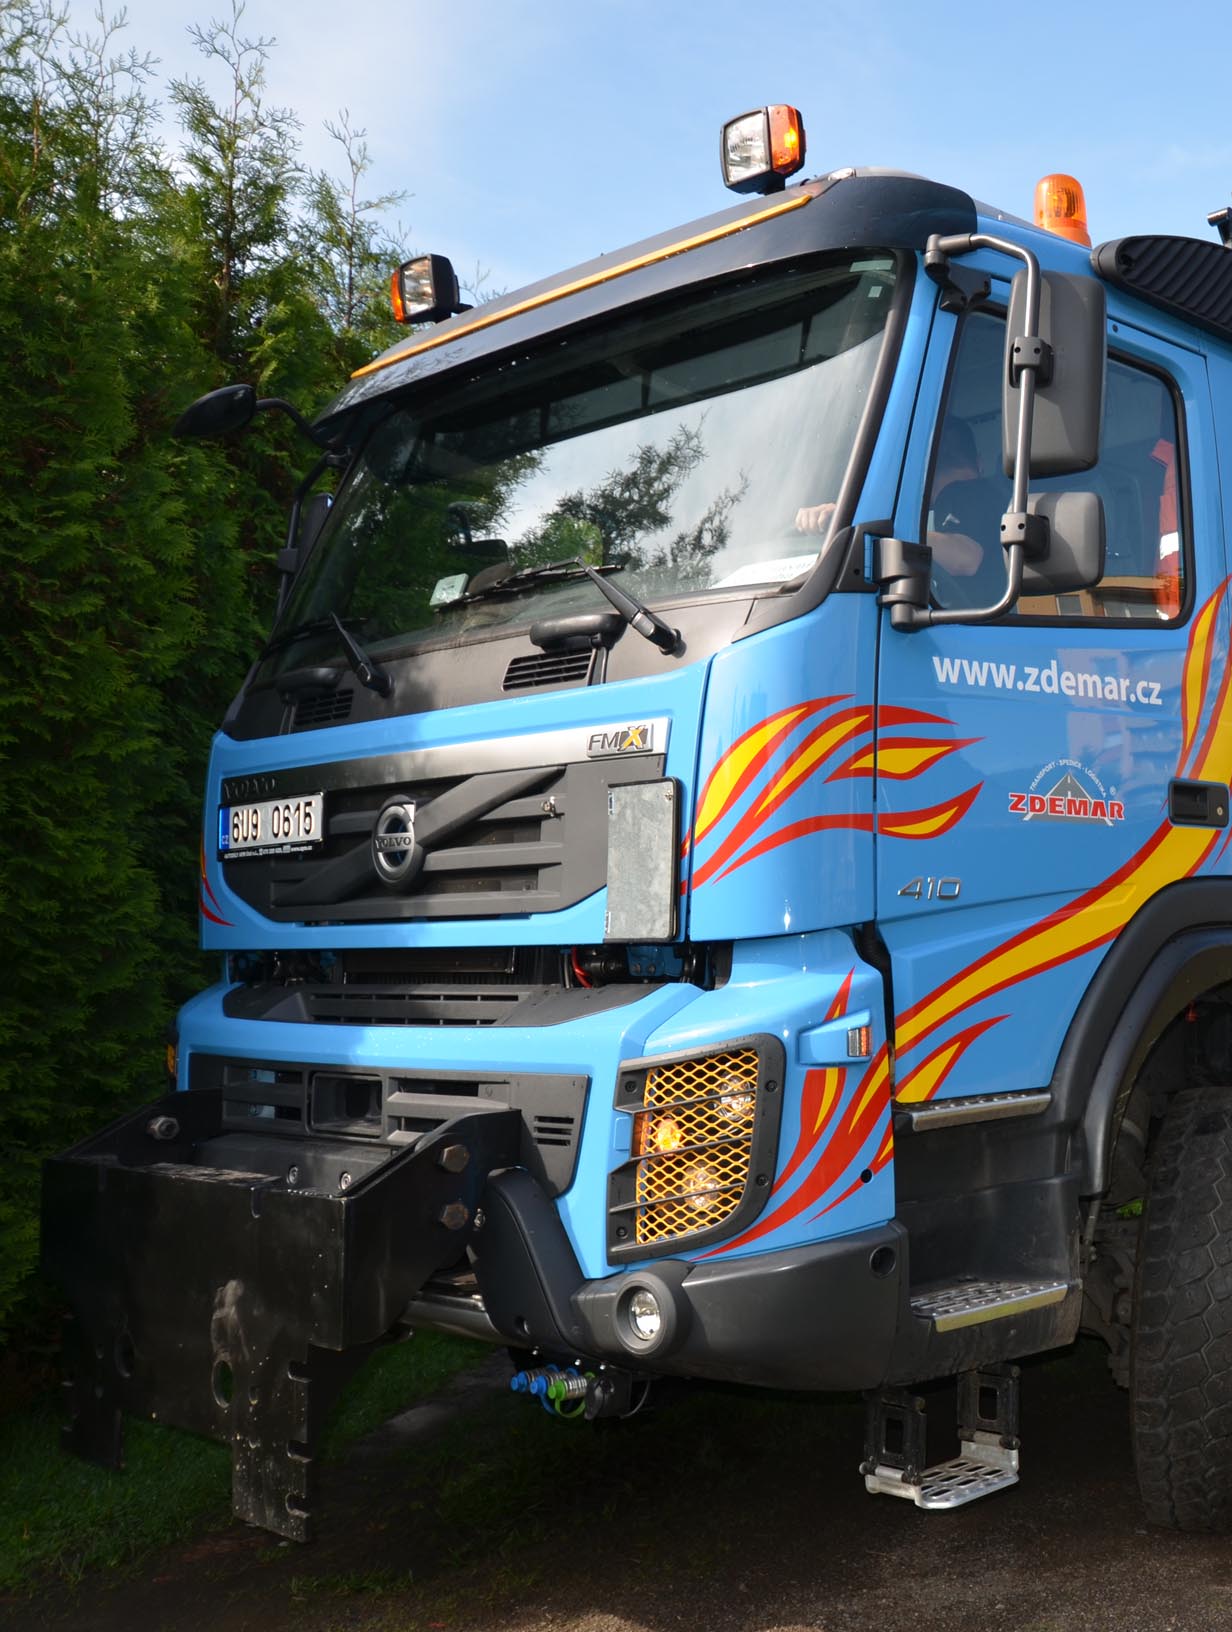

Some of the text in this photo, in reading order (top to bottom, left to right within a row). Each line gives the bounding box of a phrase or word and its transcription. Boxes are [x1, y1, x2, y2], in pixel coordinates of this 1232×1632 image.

[932, 655, 1163, 705] www.zdemar.cz
[588, 724, 648, 752] FMX
[1029, 761, 1056, 791] TRANSPORT
[1008, 793, 1125, 820] ZDEMAR
[232, 801, 315, 843] 6U9 0615
[375, 836, 411, 849] VOLVO
[897, 876, 961, 900] 410
